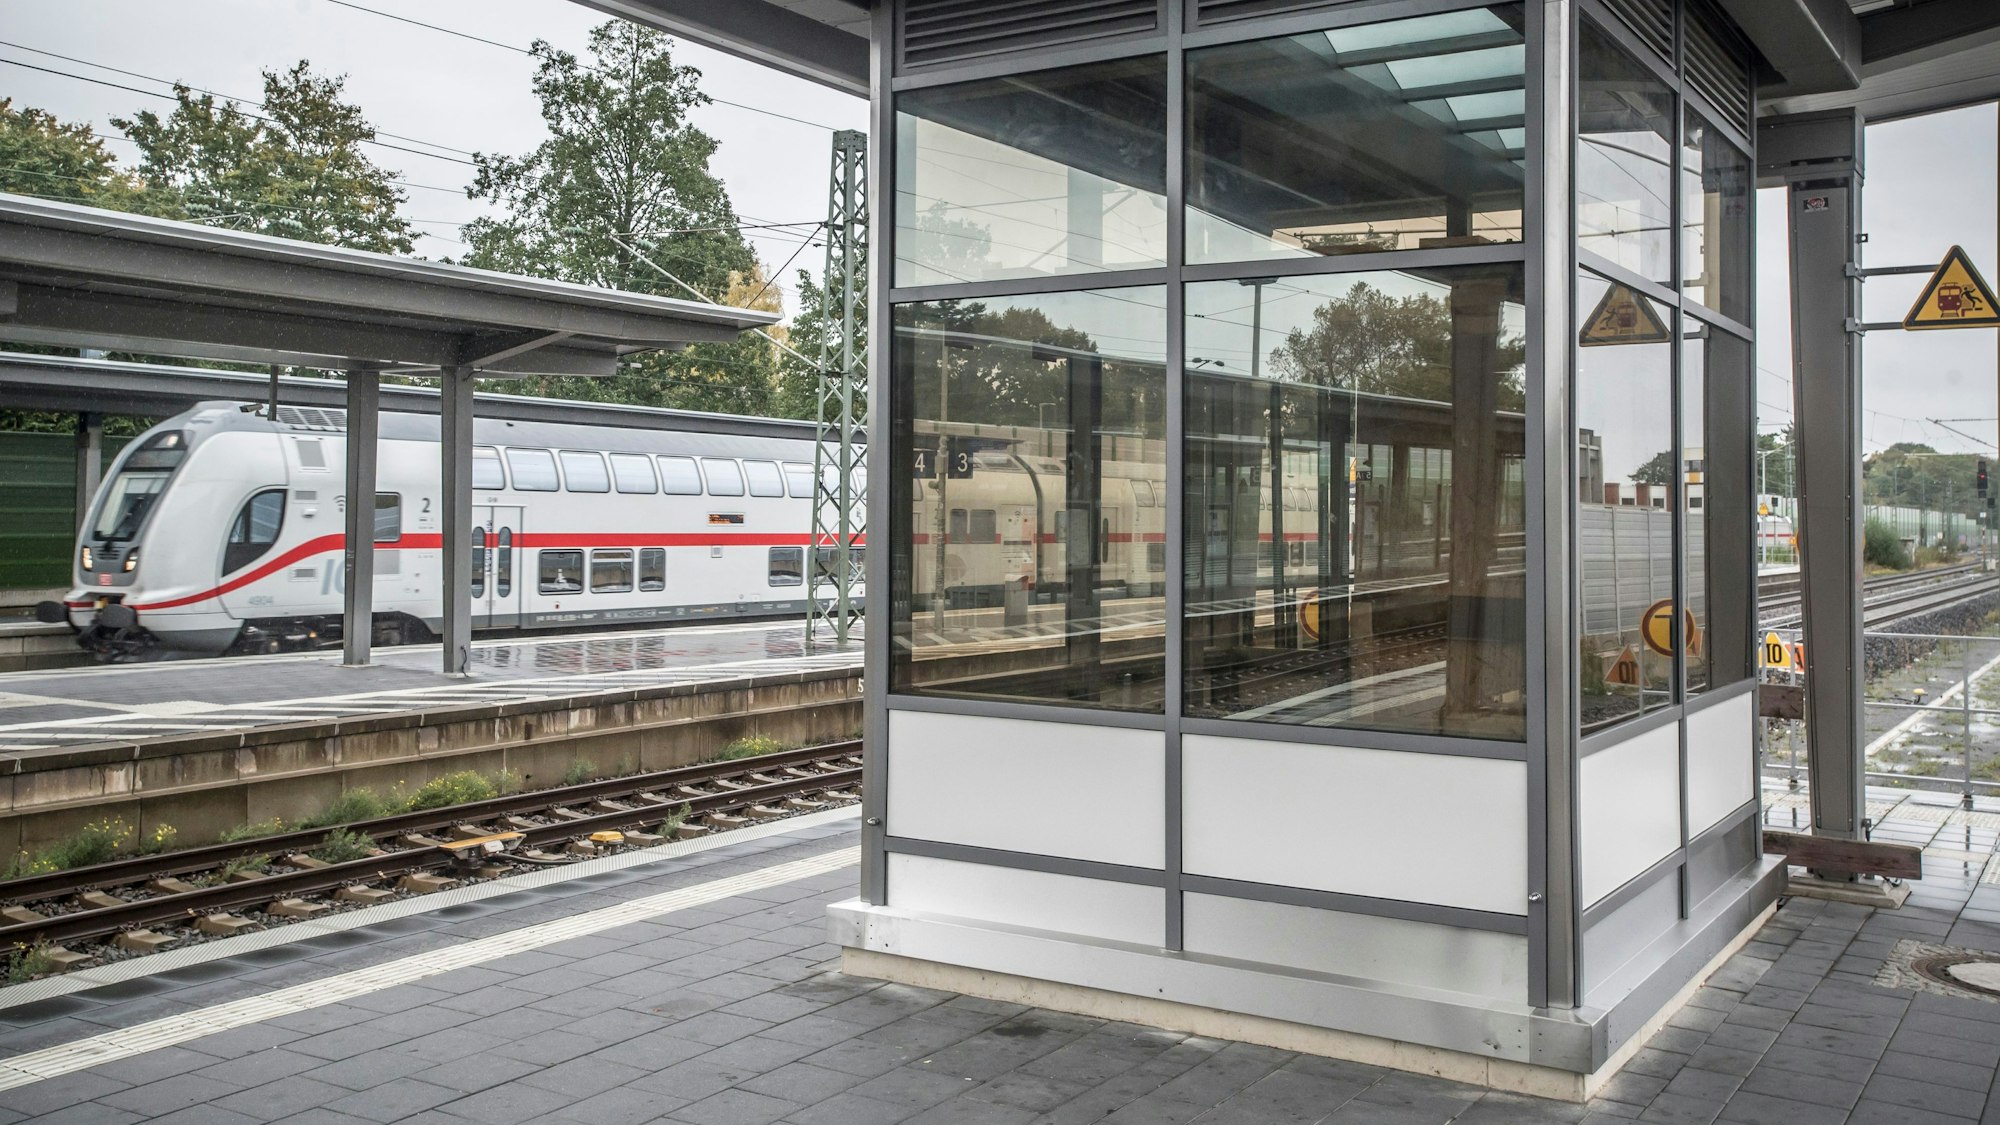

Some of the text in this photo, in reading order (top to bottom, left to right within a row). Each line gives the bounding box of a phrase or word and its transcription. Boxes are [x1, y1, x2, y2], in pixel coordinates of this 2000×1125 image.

[914, 453, 926, 472] 4
[957, 453, 968, 472] 3
[422, 498, 431, 513] 2
[1766, 643, 1782, 664] 10
[857, 677, 864, 692] 5
